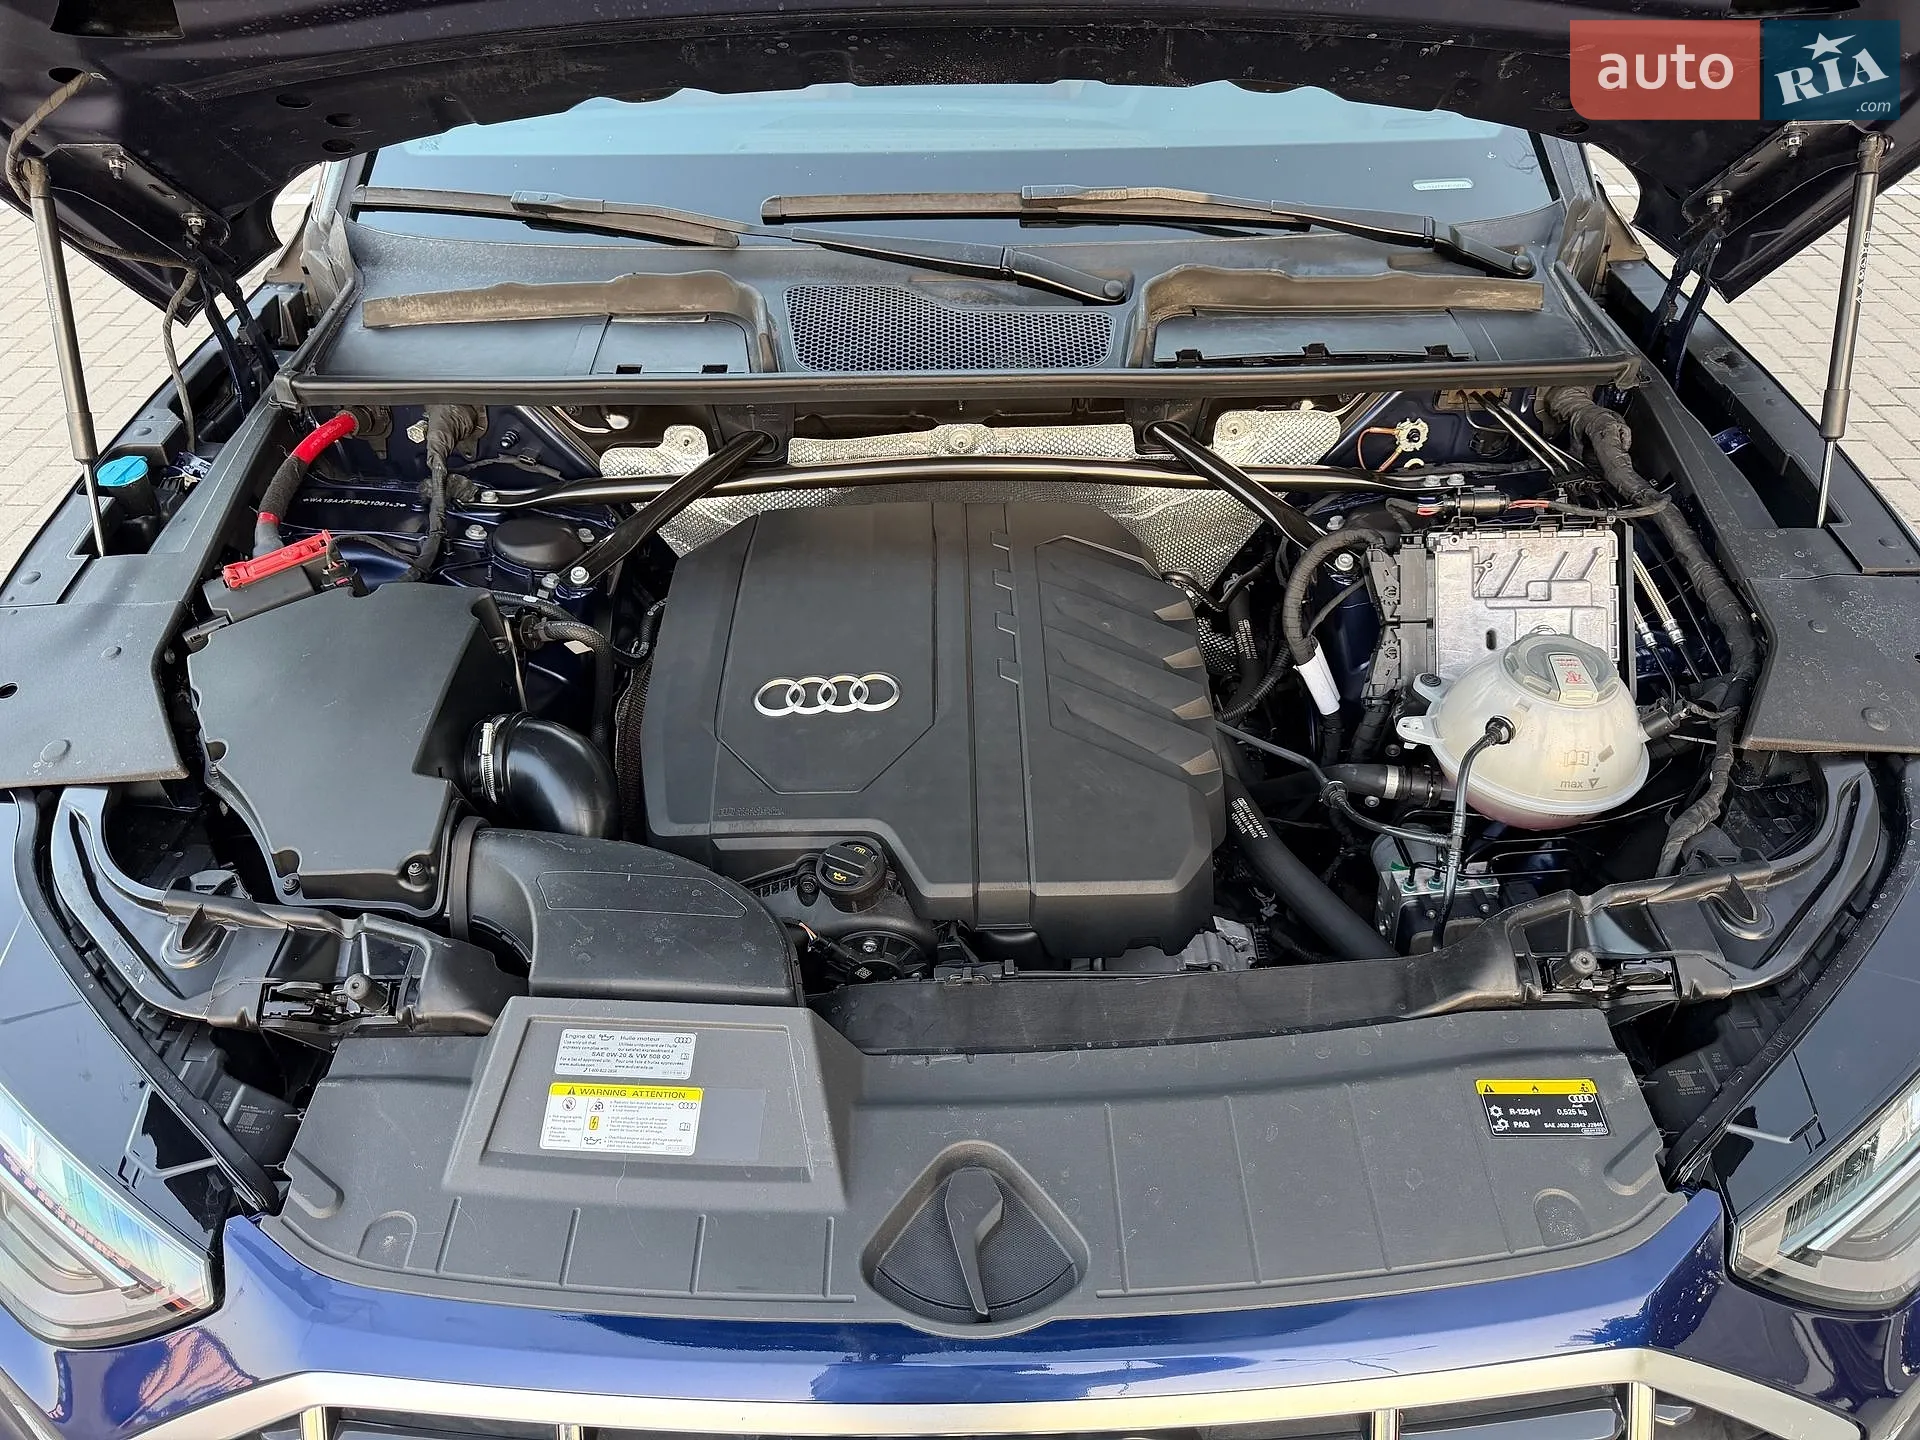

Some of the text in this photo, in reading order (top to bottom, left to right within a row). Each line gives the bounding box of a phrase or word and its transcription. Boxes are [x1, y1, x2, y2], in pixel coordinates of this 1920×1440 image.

[1560, 779, 1584, 789] max
[580, 1088, 686, 1099] WARNING ATTENTION
[1577, 1108, 1588, 1116] kg
